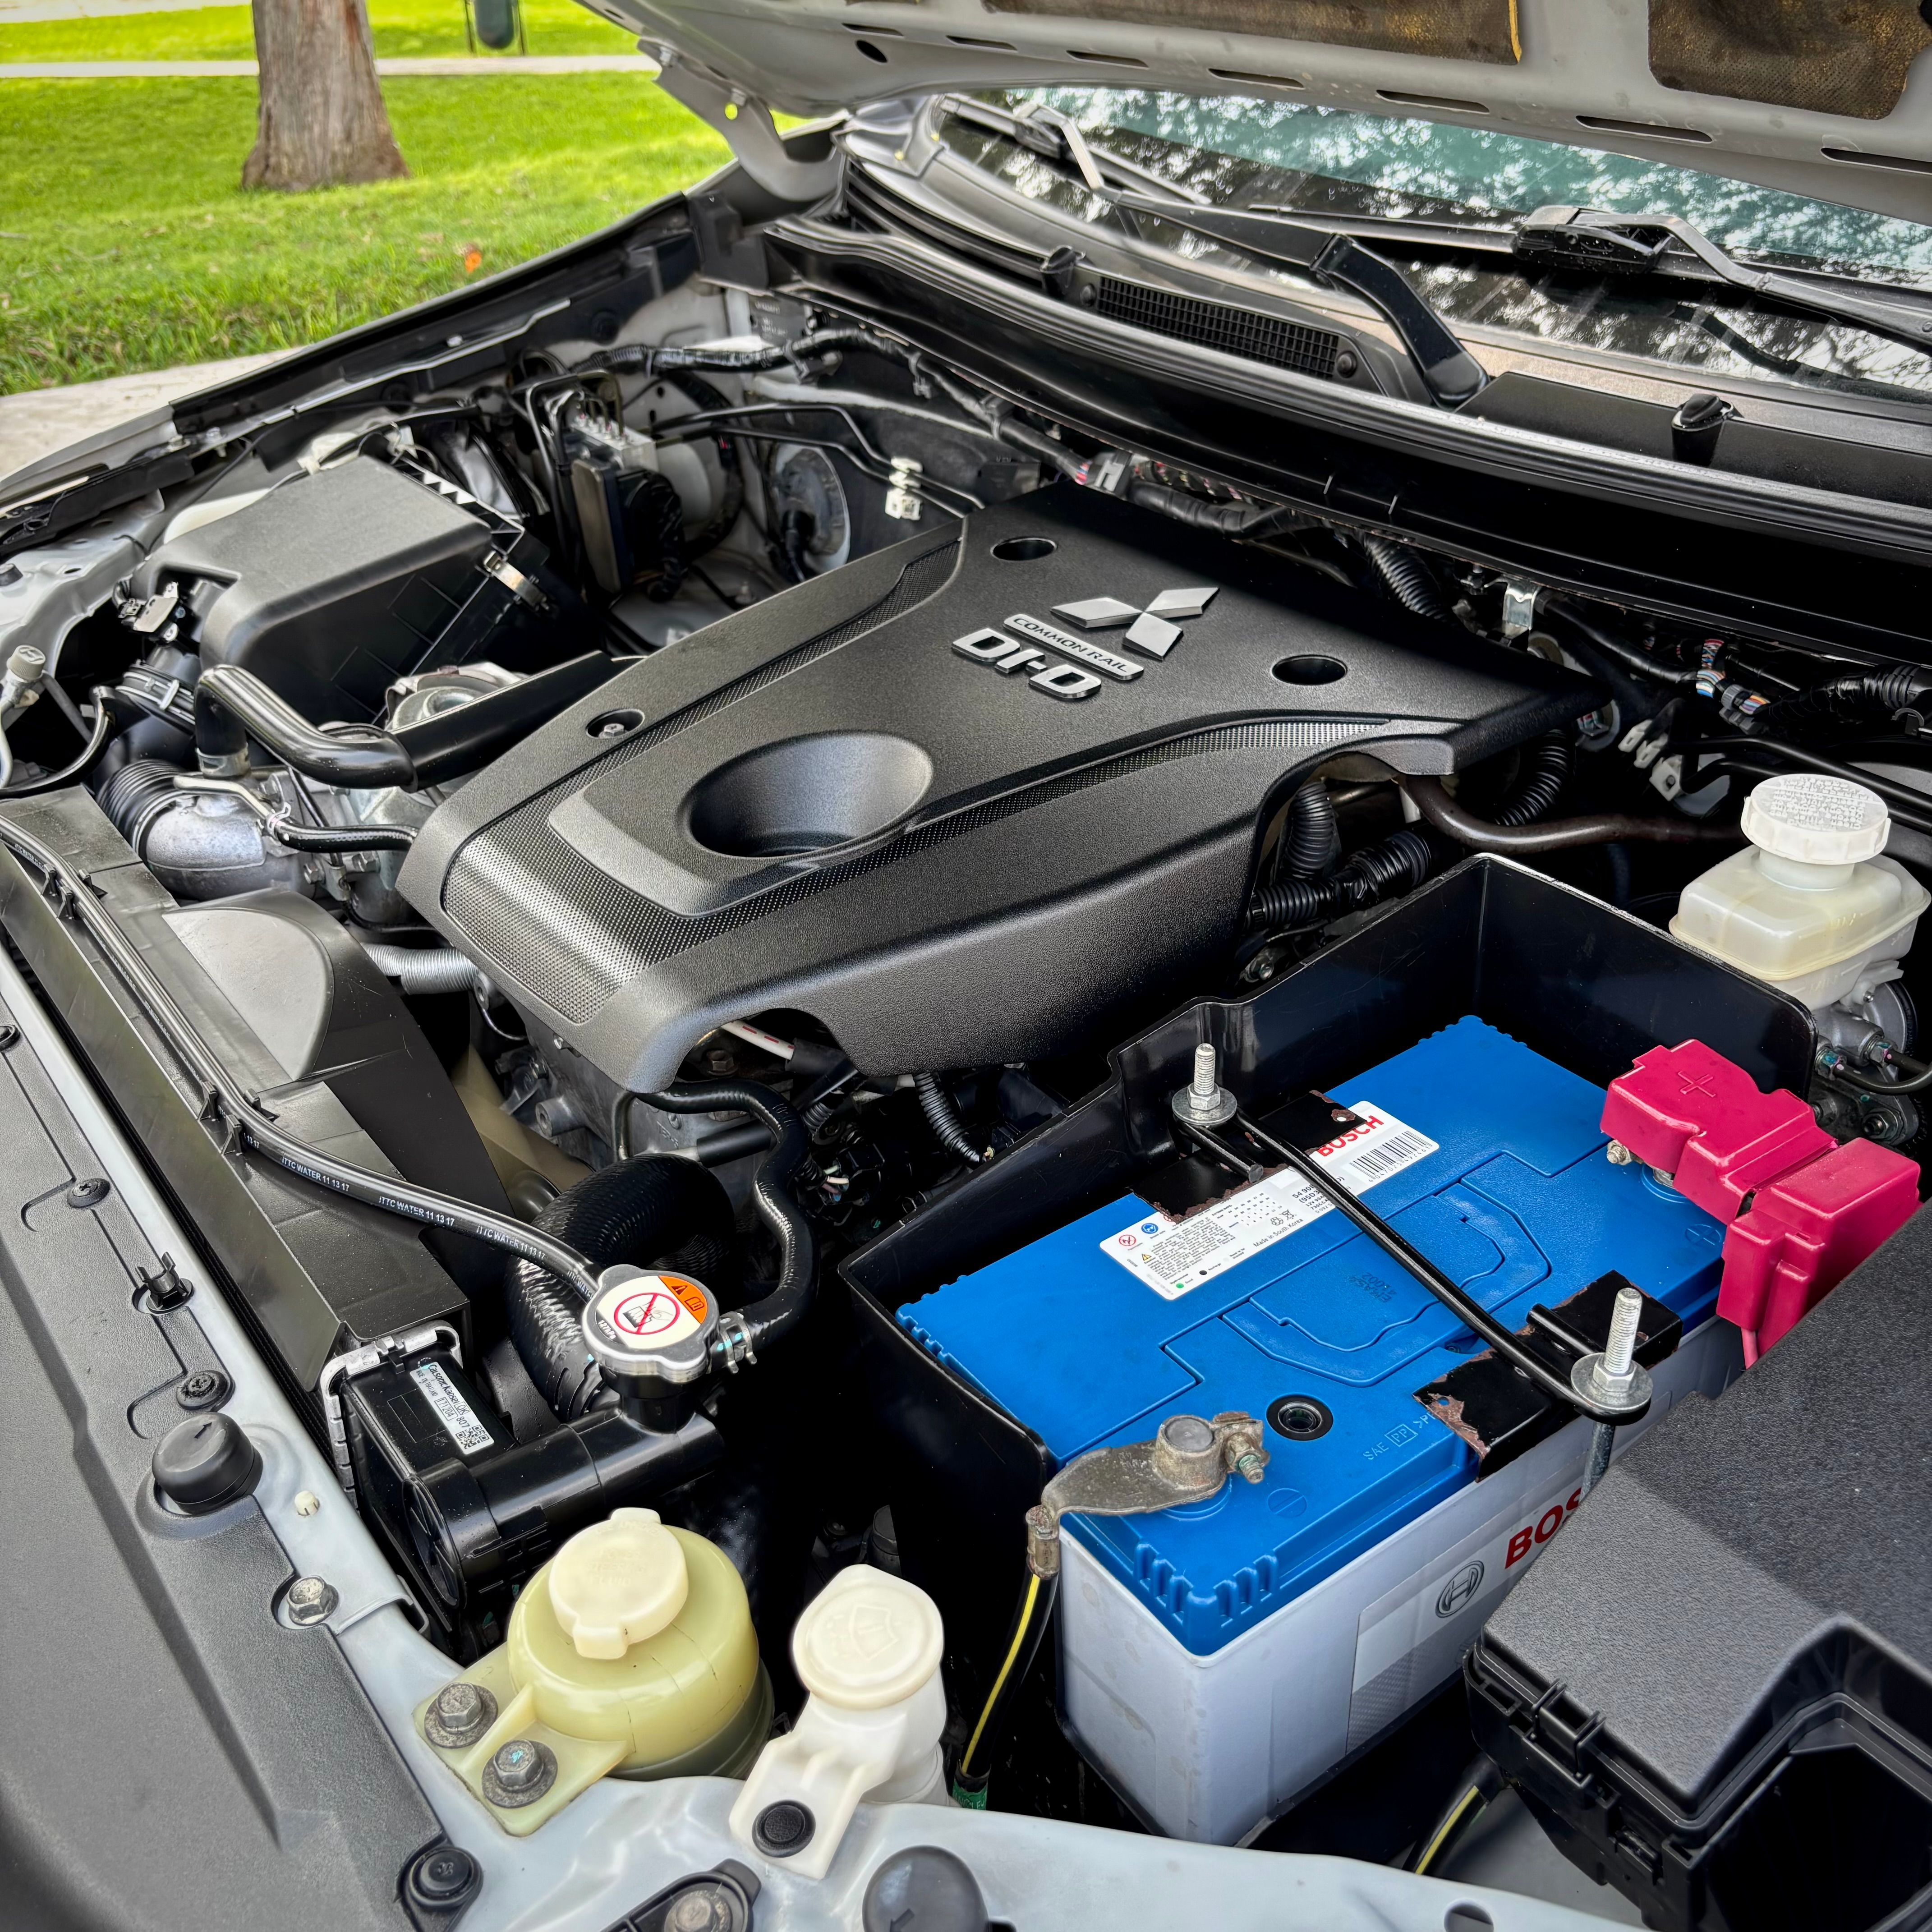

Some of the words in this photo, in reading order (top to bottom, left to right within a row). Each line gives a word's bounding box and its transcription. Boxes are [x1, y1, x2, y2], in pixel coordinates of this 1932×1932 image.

[1014, 618, 1087, 654] COMMON
[1087, 651, 1128, 672] RAIL
[952, 628, 1101, 699] DI-D
[1317, 1115, 1384, 1157] BOSCH
[297, 1164, 322, 1182] WATER
[322, 1175, 330, 1185] 11
[332, 1179, 340, 1188] 13
[341, 1182, 350, 1192] 17
[1298, 1190, 1320, 1204] (95D3
[396, 1201, 424, 1217] WATER
[426, 1211, 434, 1220] 11
[436, 1214, 445, 1223] 13
[446, 1217, 455, 1226] 17
[493, 1232, 519, 1248] WATER
[529, 1244, 537, 1255] 13
[538, 1249, 546, 1259] 17
[1253, 1237, 1269, 1247] Made
[1273, 1226, 1289, 1236] South
[1288, 1218, 1304, 1228] Korea
[436, 1398, 455, 1417] 171204
[457, 1404, 469, 1416] OK
[456, 1416, 470, 1428] 807
[1363, 1442, 1389, 1460] SAE
[1391, 1428, 1407, 1442] PP
